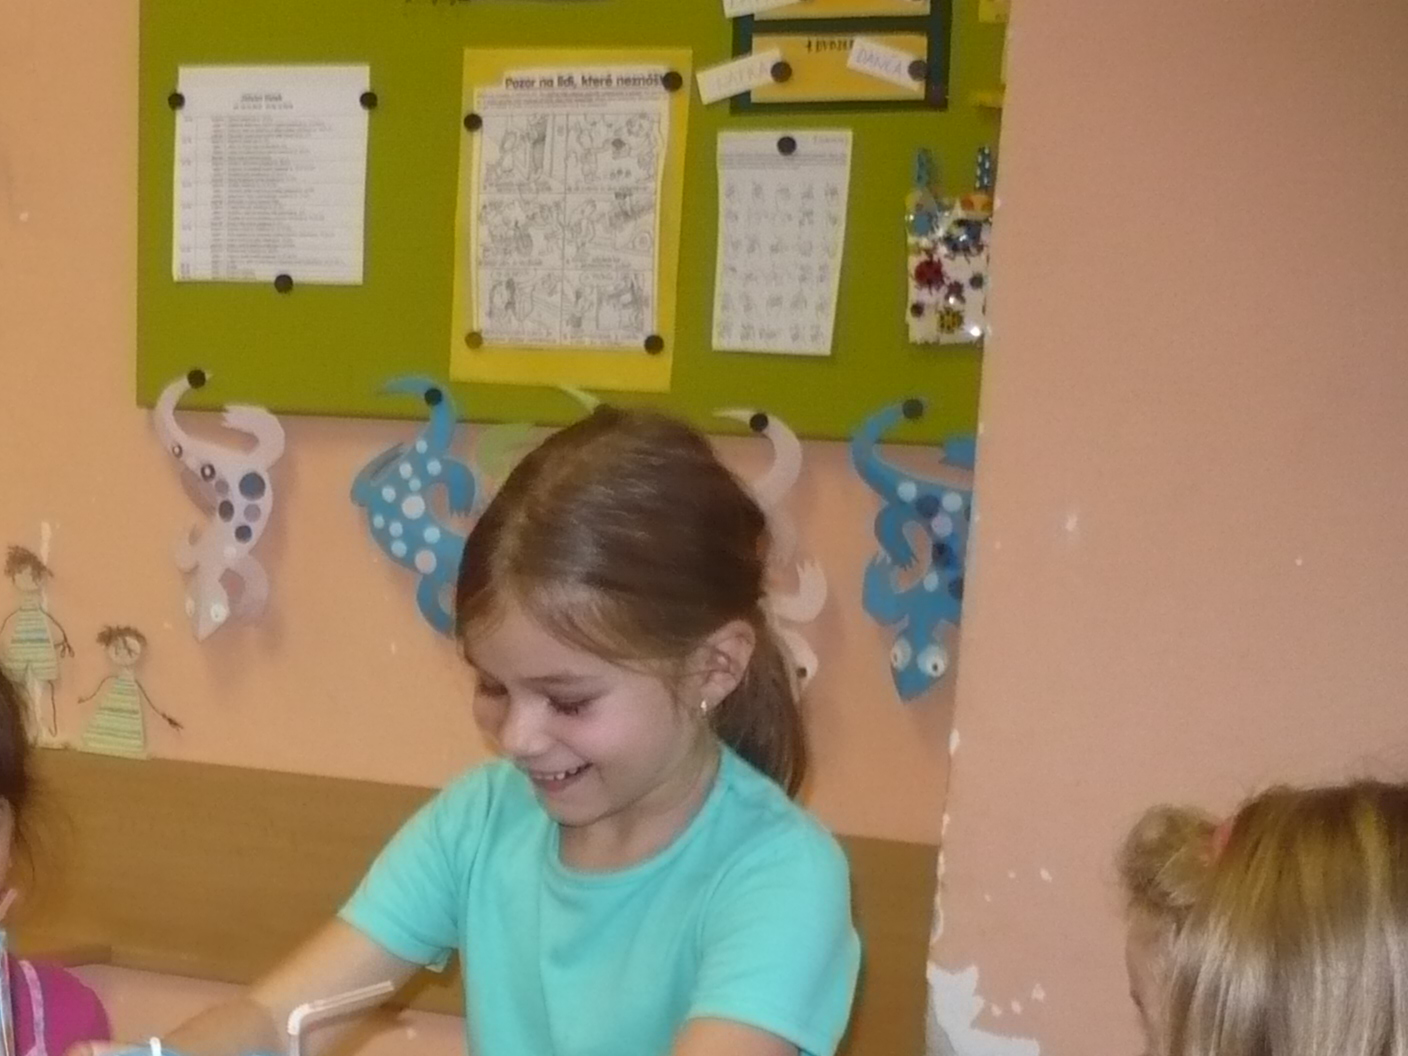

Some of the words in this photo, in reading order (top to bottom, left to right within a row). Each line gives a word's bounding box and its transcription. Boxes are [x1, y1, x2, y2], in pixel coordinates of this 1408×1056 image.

[504, 78, 535, 89] Pozor
[539, 78, 554, 88] na
[557, 75, 577, 89] lidi,
[581, 74, 613, 87] které
